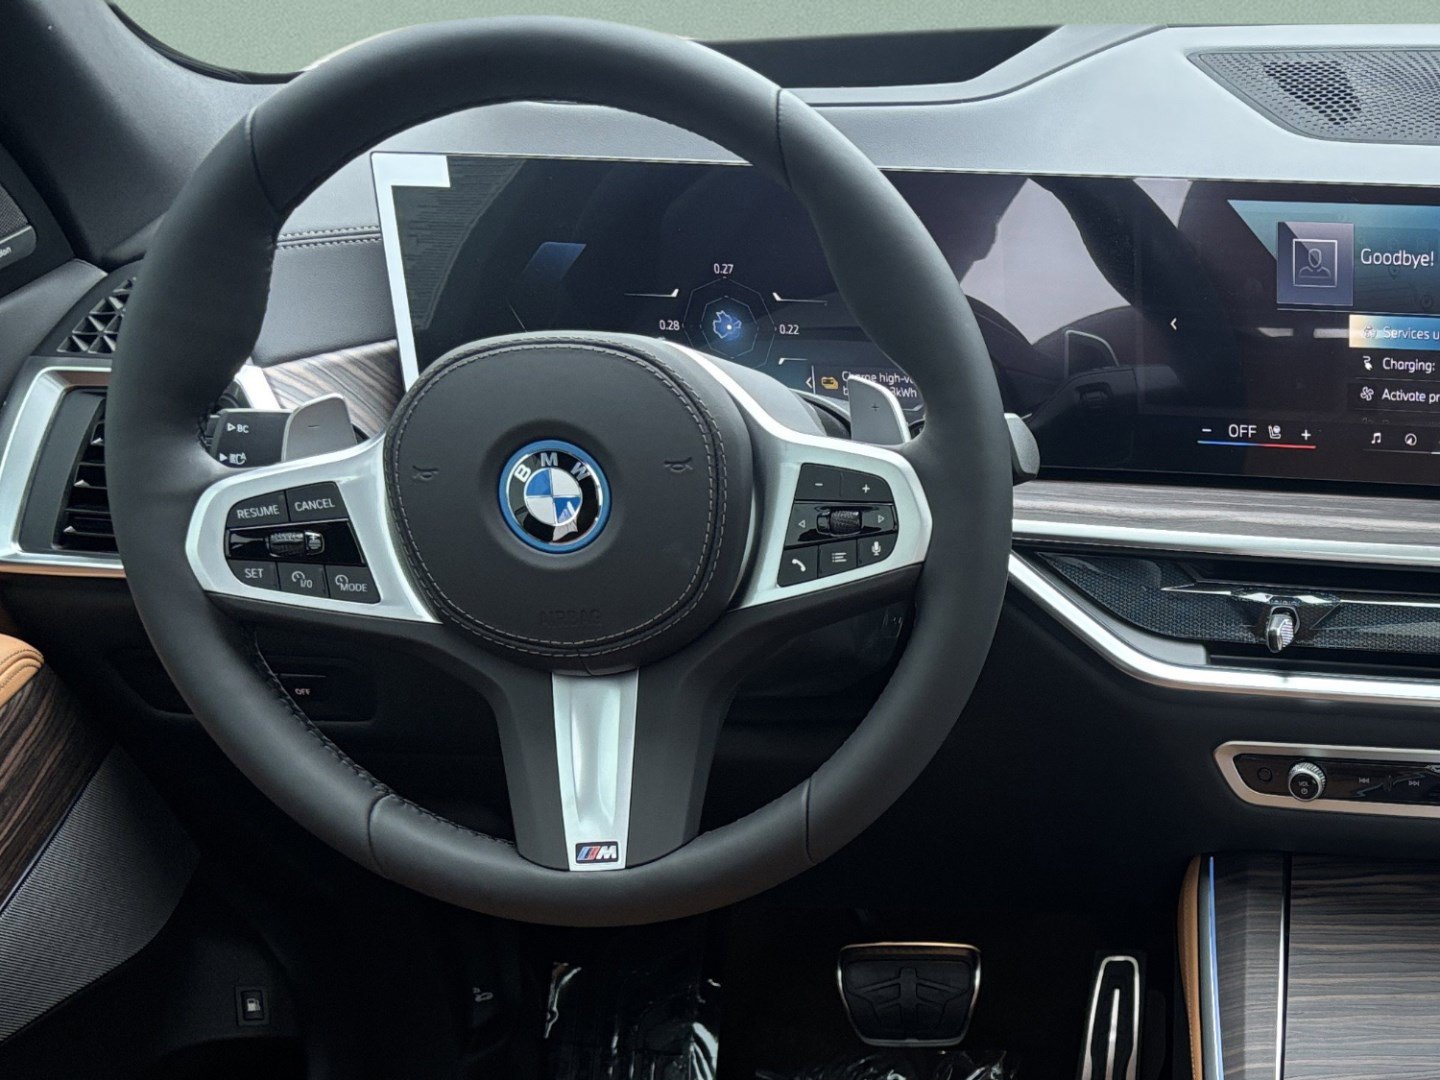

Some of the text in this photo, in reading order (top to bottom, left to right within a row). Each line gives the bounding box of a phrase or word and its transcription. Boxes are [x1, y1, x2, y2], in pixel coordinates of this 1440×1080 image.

[1361, 248, 1434, 269] Goodbye!
[713, 263, 734, 275] 0.27
[659, 320, 680, 331] 0.28
[779, 323, 799, 336] 0.22
[1383, 326, 1430, 340] Services
[1382, 357, 1436, 374] Charging:
[1382, 388, 1426, 402] Activate
[1228, 424, 1257, 438] OFF
[514, 452, 590, 483] BMW
[237, 504, 280, 520] RESUME
[294, 499, 336, 512] CANCEL
[244, 568, 264, 580] SET
[340, 582, 367, 593] MODE
